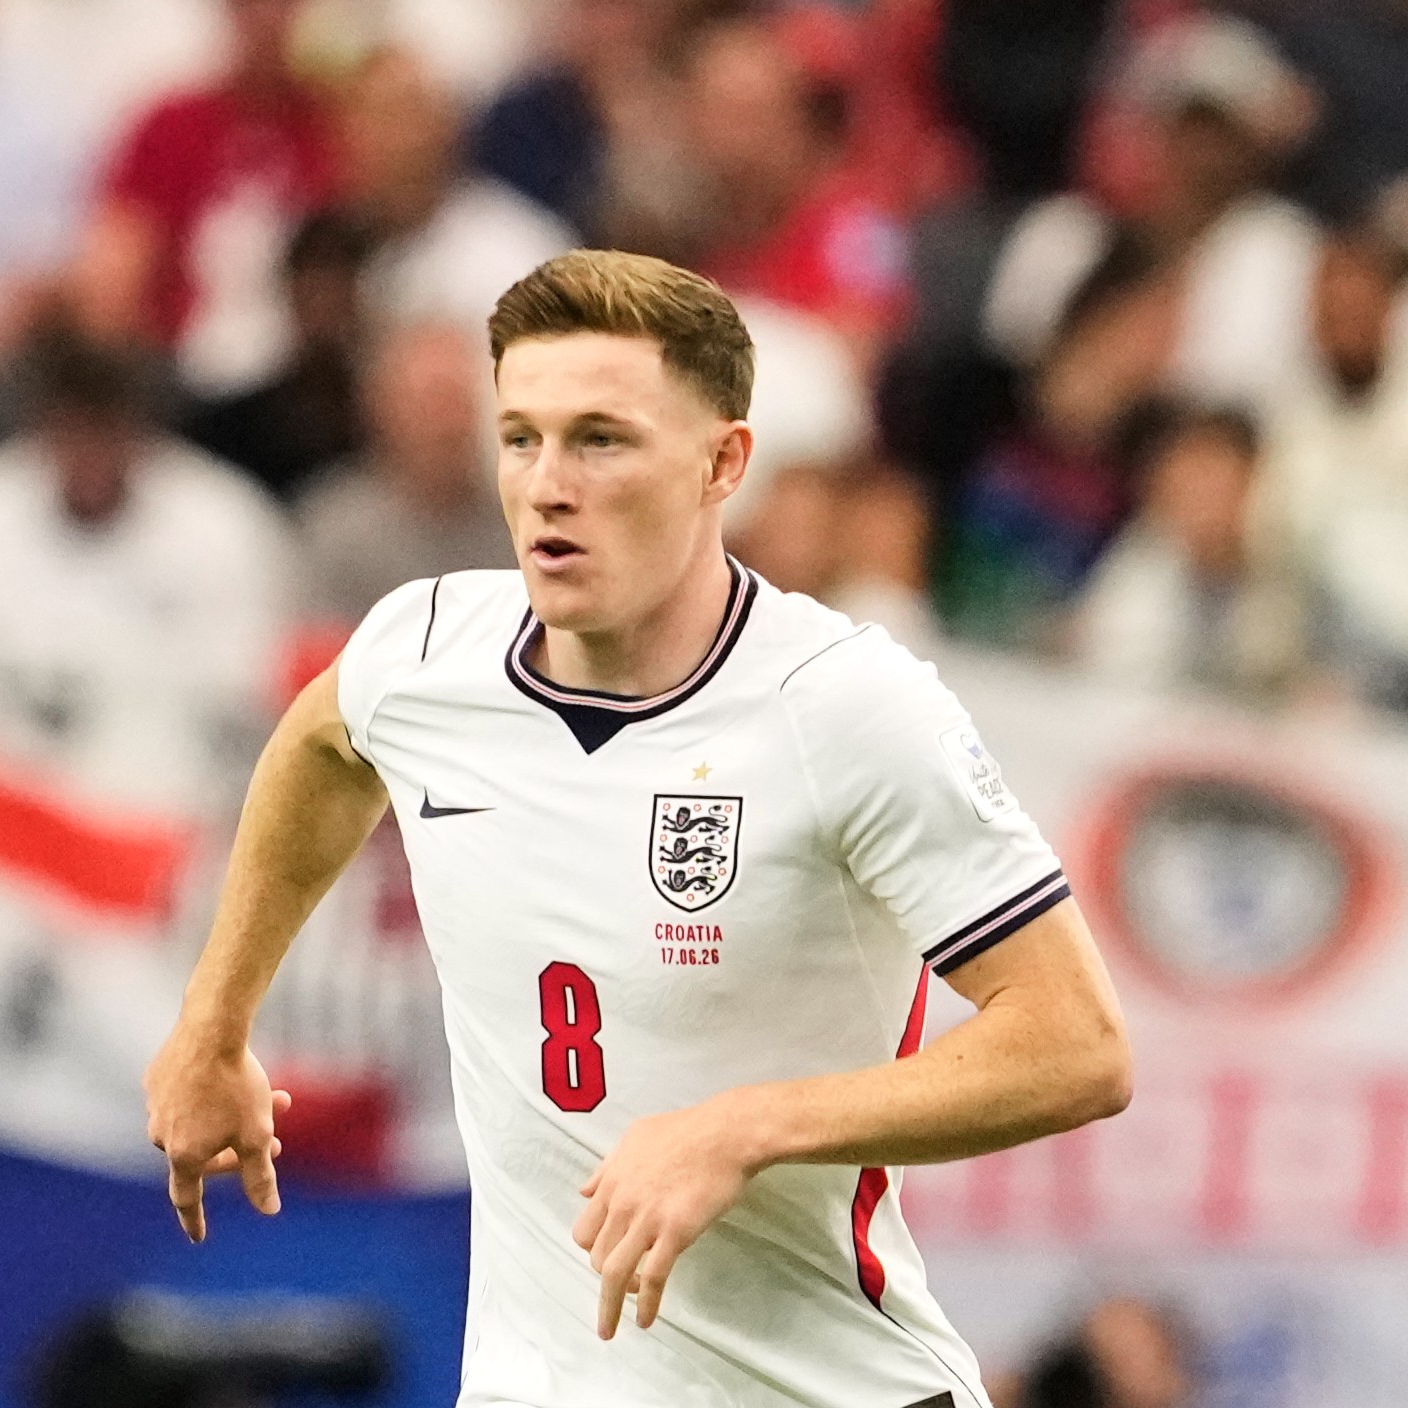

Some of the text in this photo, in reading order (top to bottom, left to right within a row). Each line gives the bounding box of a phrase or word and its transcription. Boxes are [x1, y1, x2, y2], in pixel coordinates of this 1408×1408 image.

[655, 923, 723, 942] CROATIA
[661, 947, 720, 965] 17.06.26
[538, 960, 607, 1113] 8
